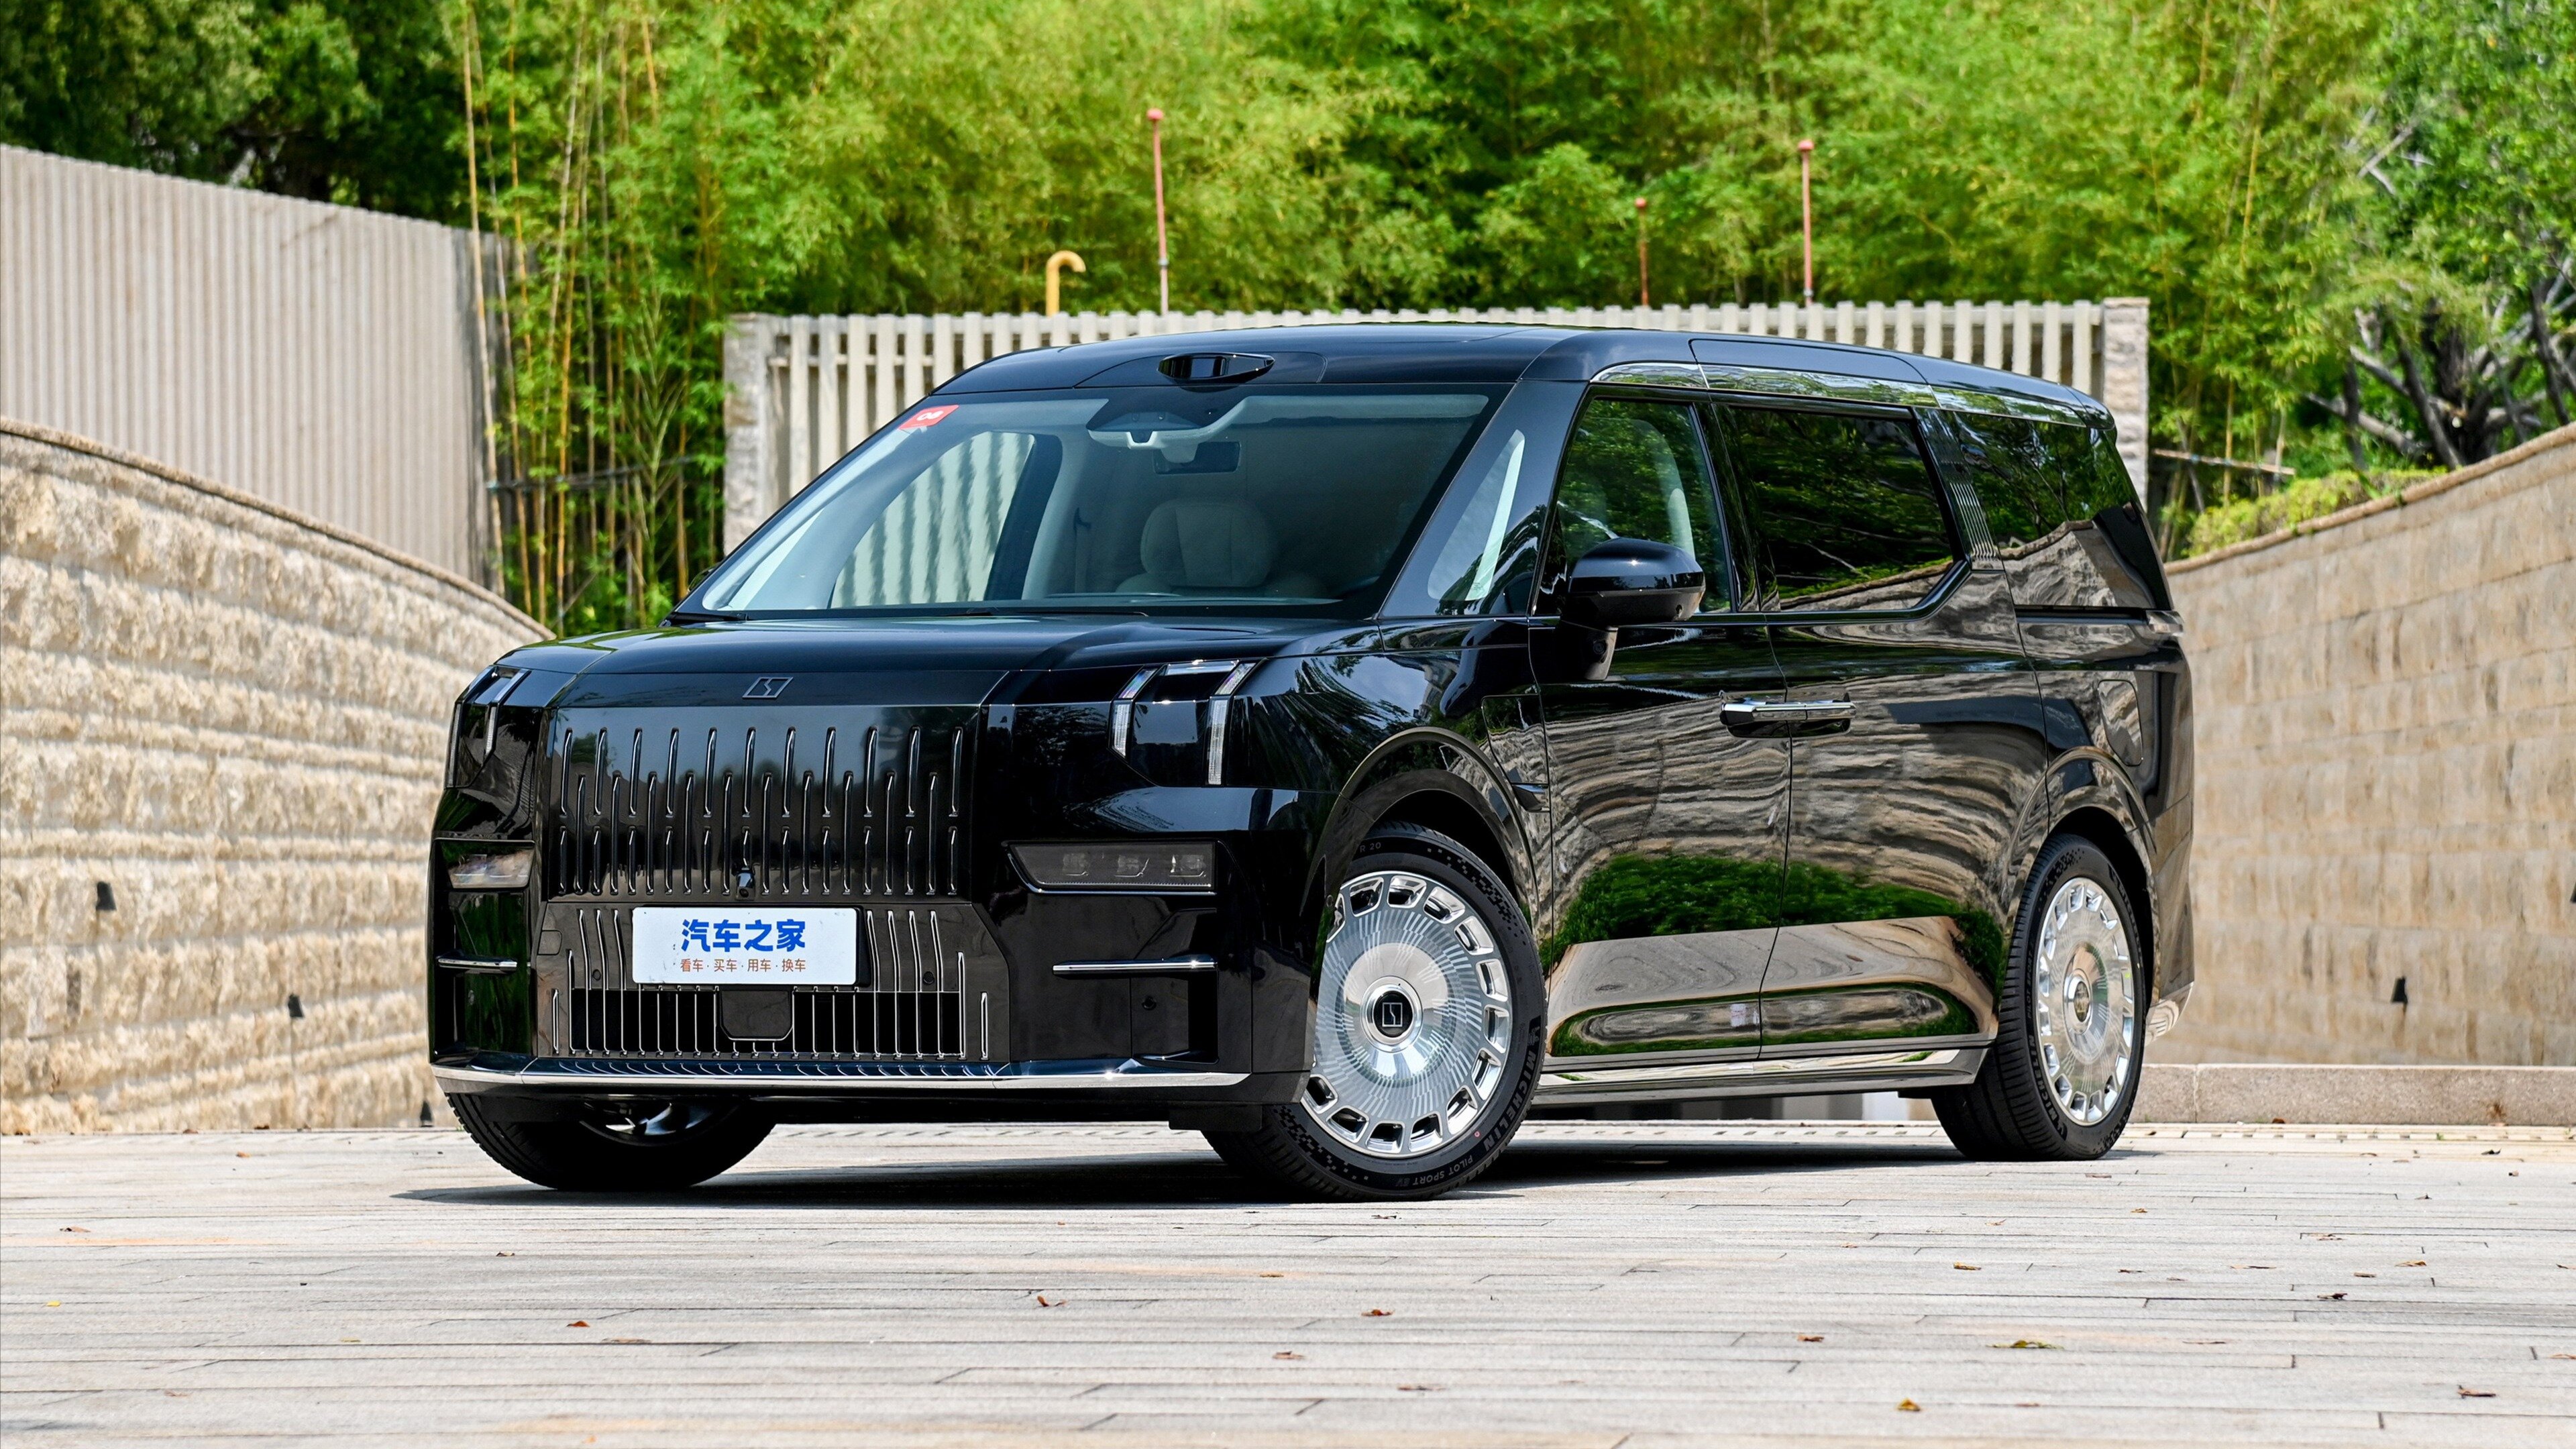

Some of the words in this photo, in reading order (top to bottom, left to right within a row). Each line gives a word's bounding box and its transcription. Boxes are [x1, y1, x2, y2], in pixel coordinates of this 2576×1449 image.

[1359, 845, 1366, 853] R
[1369, 842, 1381, 851] 20
[681, 919, 805, 952] 汽车之家
[2029, 1034, 2057, 1121] MICHELIN
[1483, 1050, 1536, 1151] MICHELIN
[1412, 1171, 1445, 1185] SPORT
[1448, 1155, 1473, 1175] PILOT
